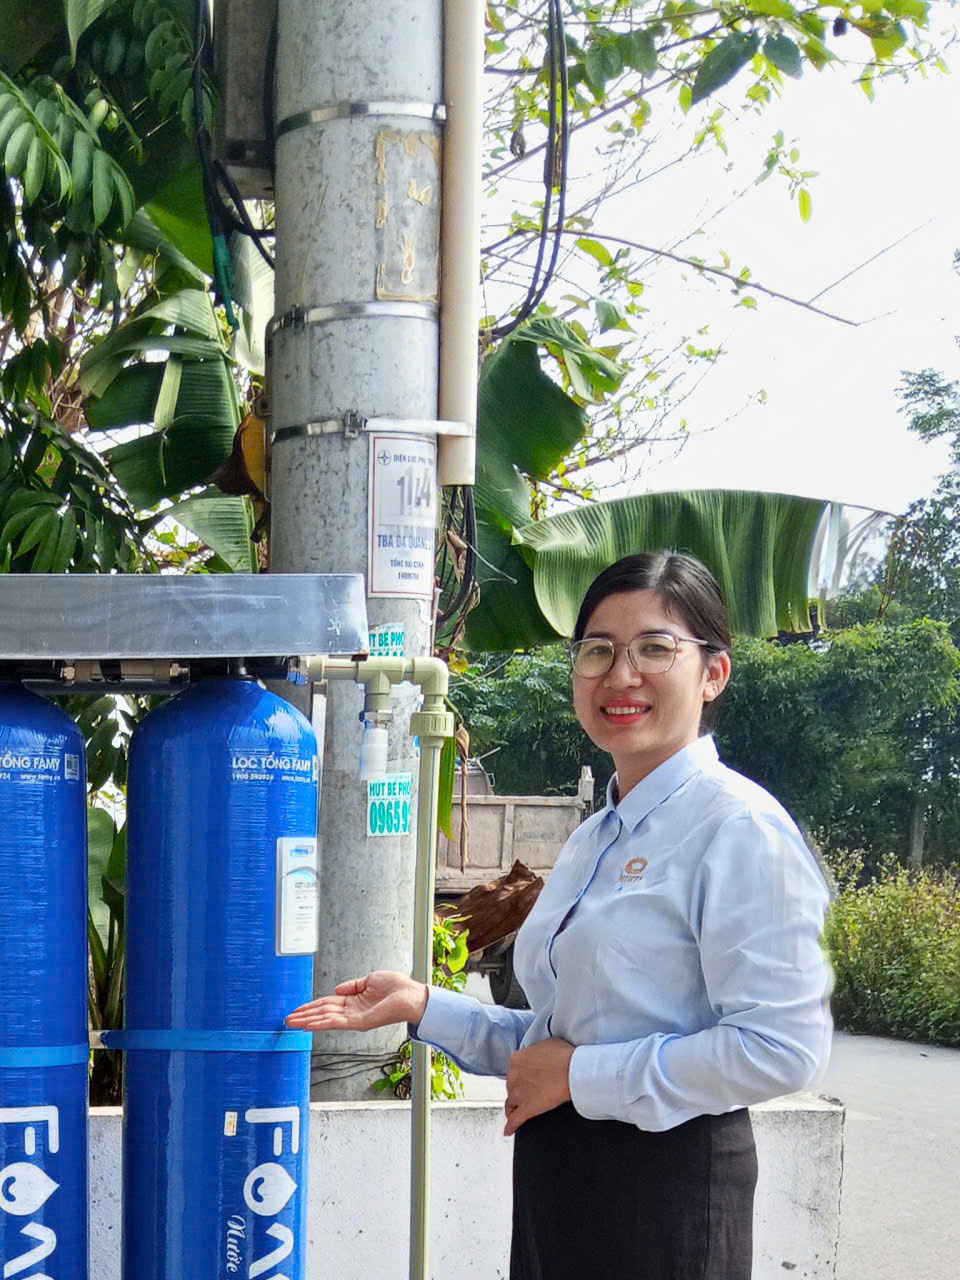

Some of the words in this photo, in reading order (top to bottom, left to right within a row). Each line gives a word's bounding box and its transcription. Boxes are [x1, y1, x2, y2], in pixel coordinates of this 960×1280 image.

[33, 759, 60, 771] FAMY
[232, 757, 258, 772] LỌC
[261, 752, 290, 770] TỔNG
